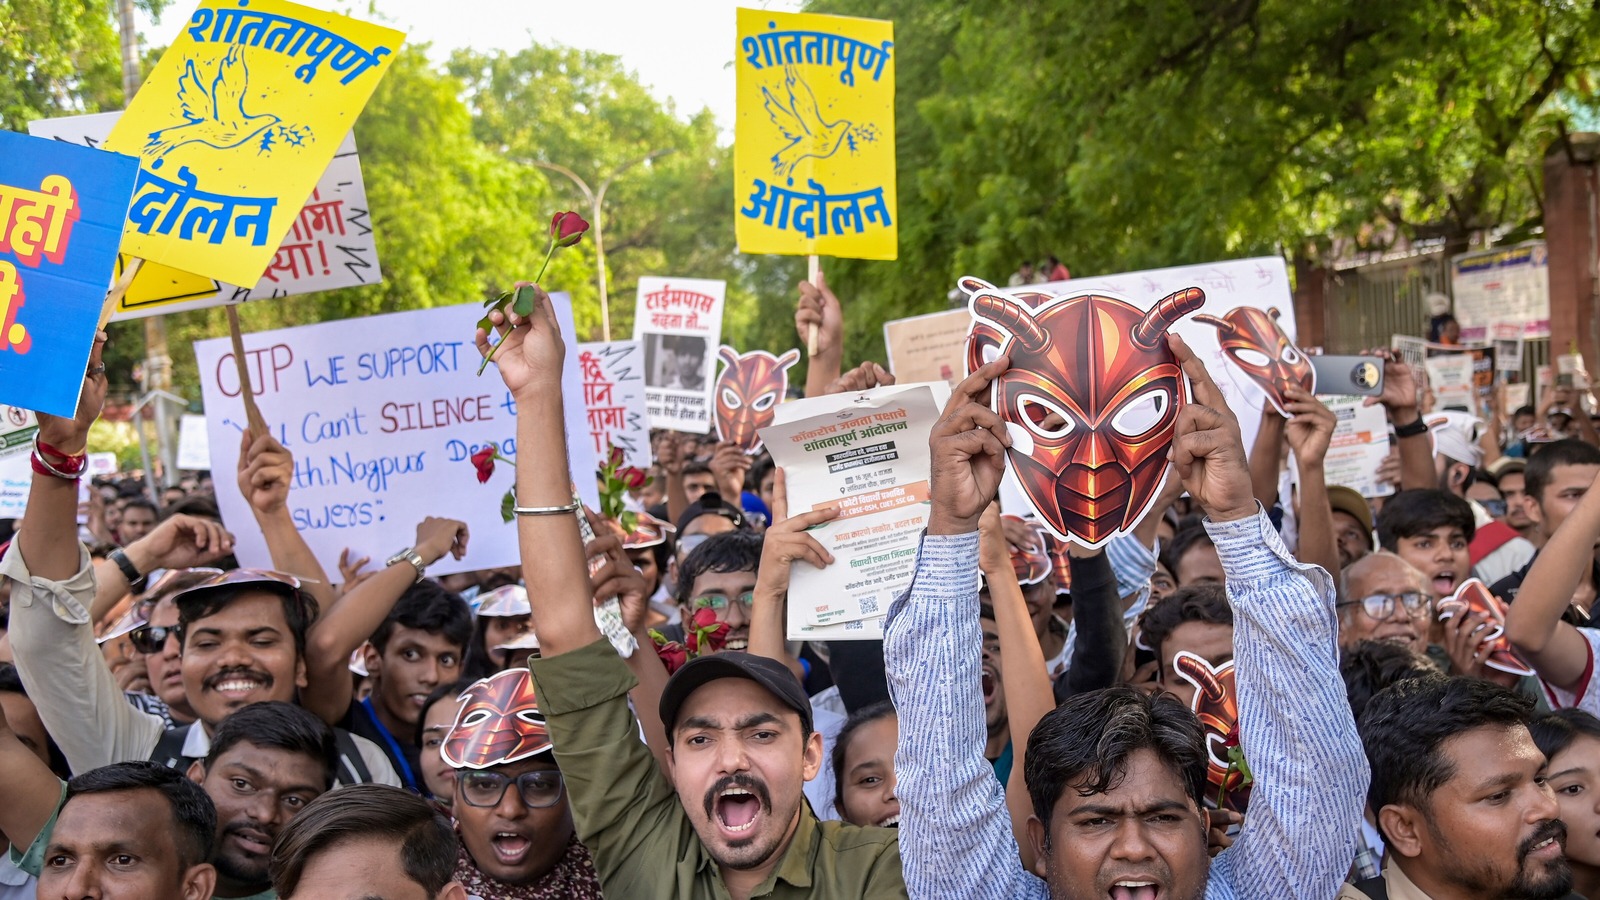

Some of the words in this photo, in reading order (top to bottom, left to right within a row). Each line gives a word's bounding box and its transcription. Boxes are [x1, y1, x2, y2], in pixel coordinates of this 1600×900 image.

[188, 0, 392, 85] शांततापूर्ण
[741, 21, 894, 87] शांततापूर्ण
[128, 157, 278, 247] दोलन
[740, 177, 893, 239] आंदोलन
[644, 284, 715, 314] टाईमपास
[304, 356, 348, 388] WE
[357, 342, 463, 382] SUPPORT
[302, 407, 368, 444] Can't
[380, 395, 494, 433] SILENCE
[500, 391, 517, 416] t
[790, 424, 836, 442] कॉकरोच
[838, 415, 872, 430] जनता
[874, 408, 907, 421] पक्षाचे
[804, 430, 857, 452] शांततापूर्ण
[859, 421, 908, 439] आंदोलन
[844, 497, 858, 507] कोटी
